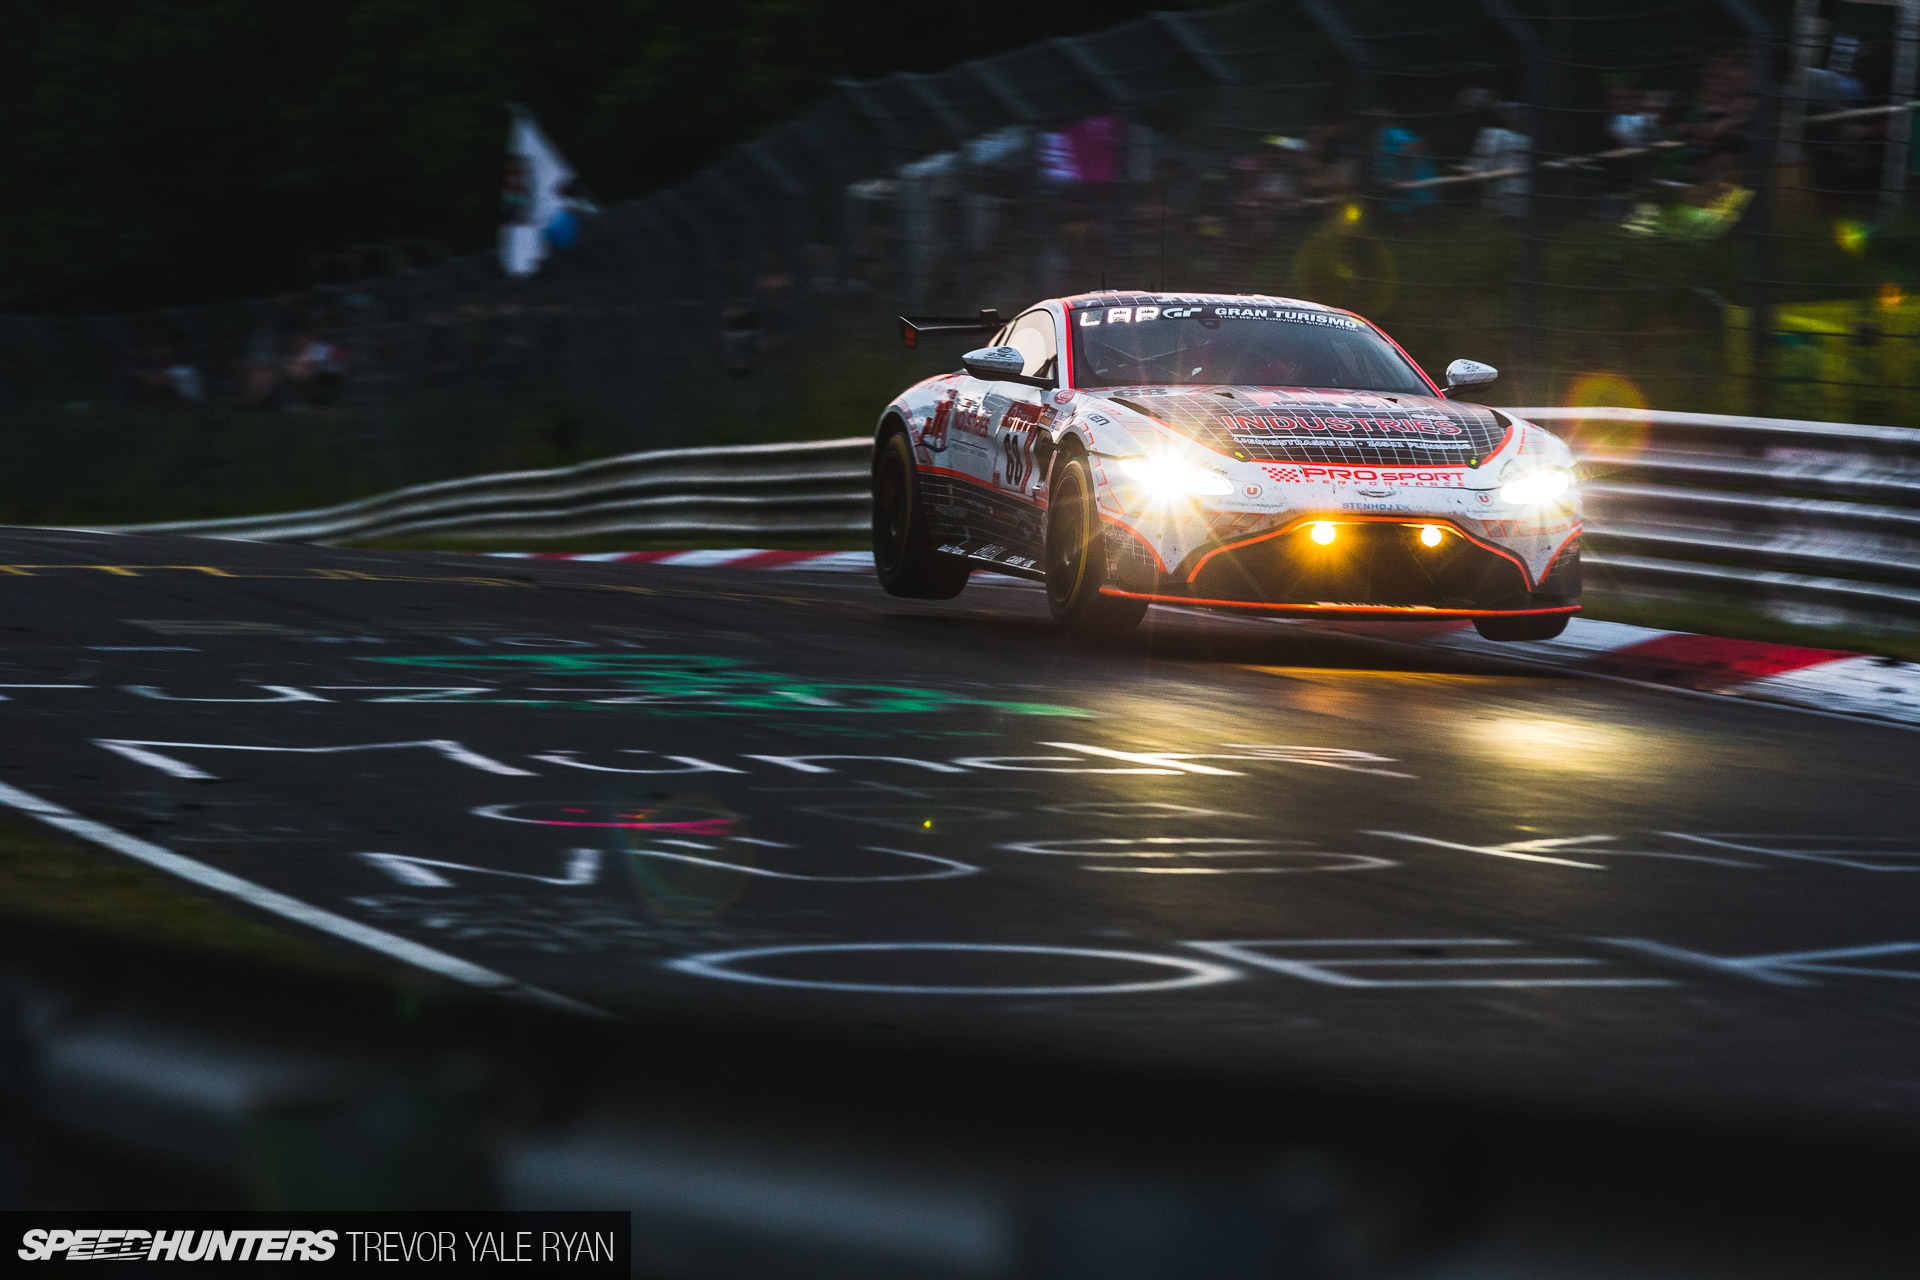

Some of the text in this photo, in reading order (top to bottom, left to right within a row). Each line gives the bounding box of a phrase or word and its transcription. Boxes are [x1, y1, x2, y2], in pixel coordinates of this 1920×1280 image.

[1215, 307, 1358, 328] GRAN TURISMO
[1266, 317, 1304, 325] DRIVING
[1306, 321, 1359, 332] SIMULATOR
[1220, 415, 1463, 435] INDUSTRIES
[1306, 478, 1466, 487] PERFORMANCE
